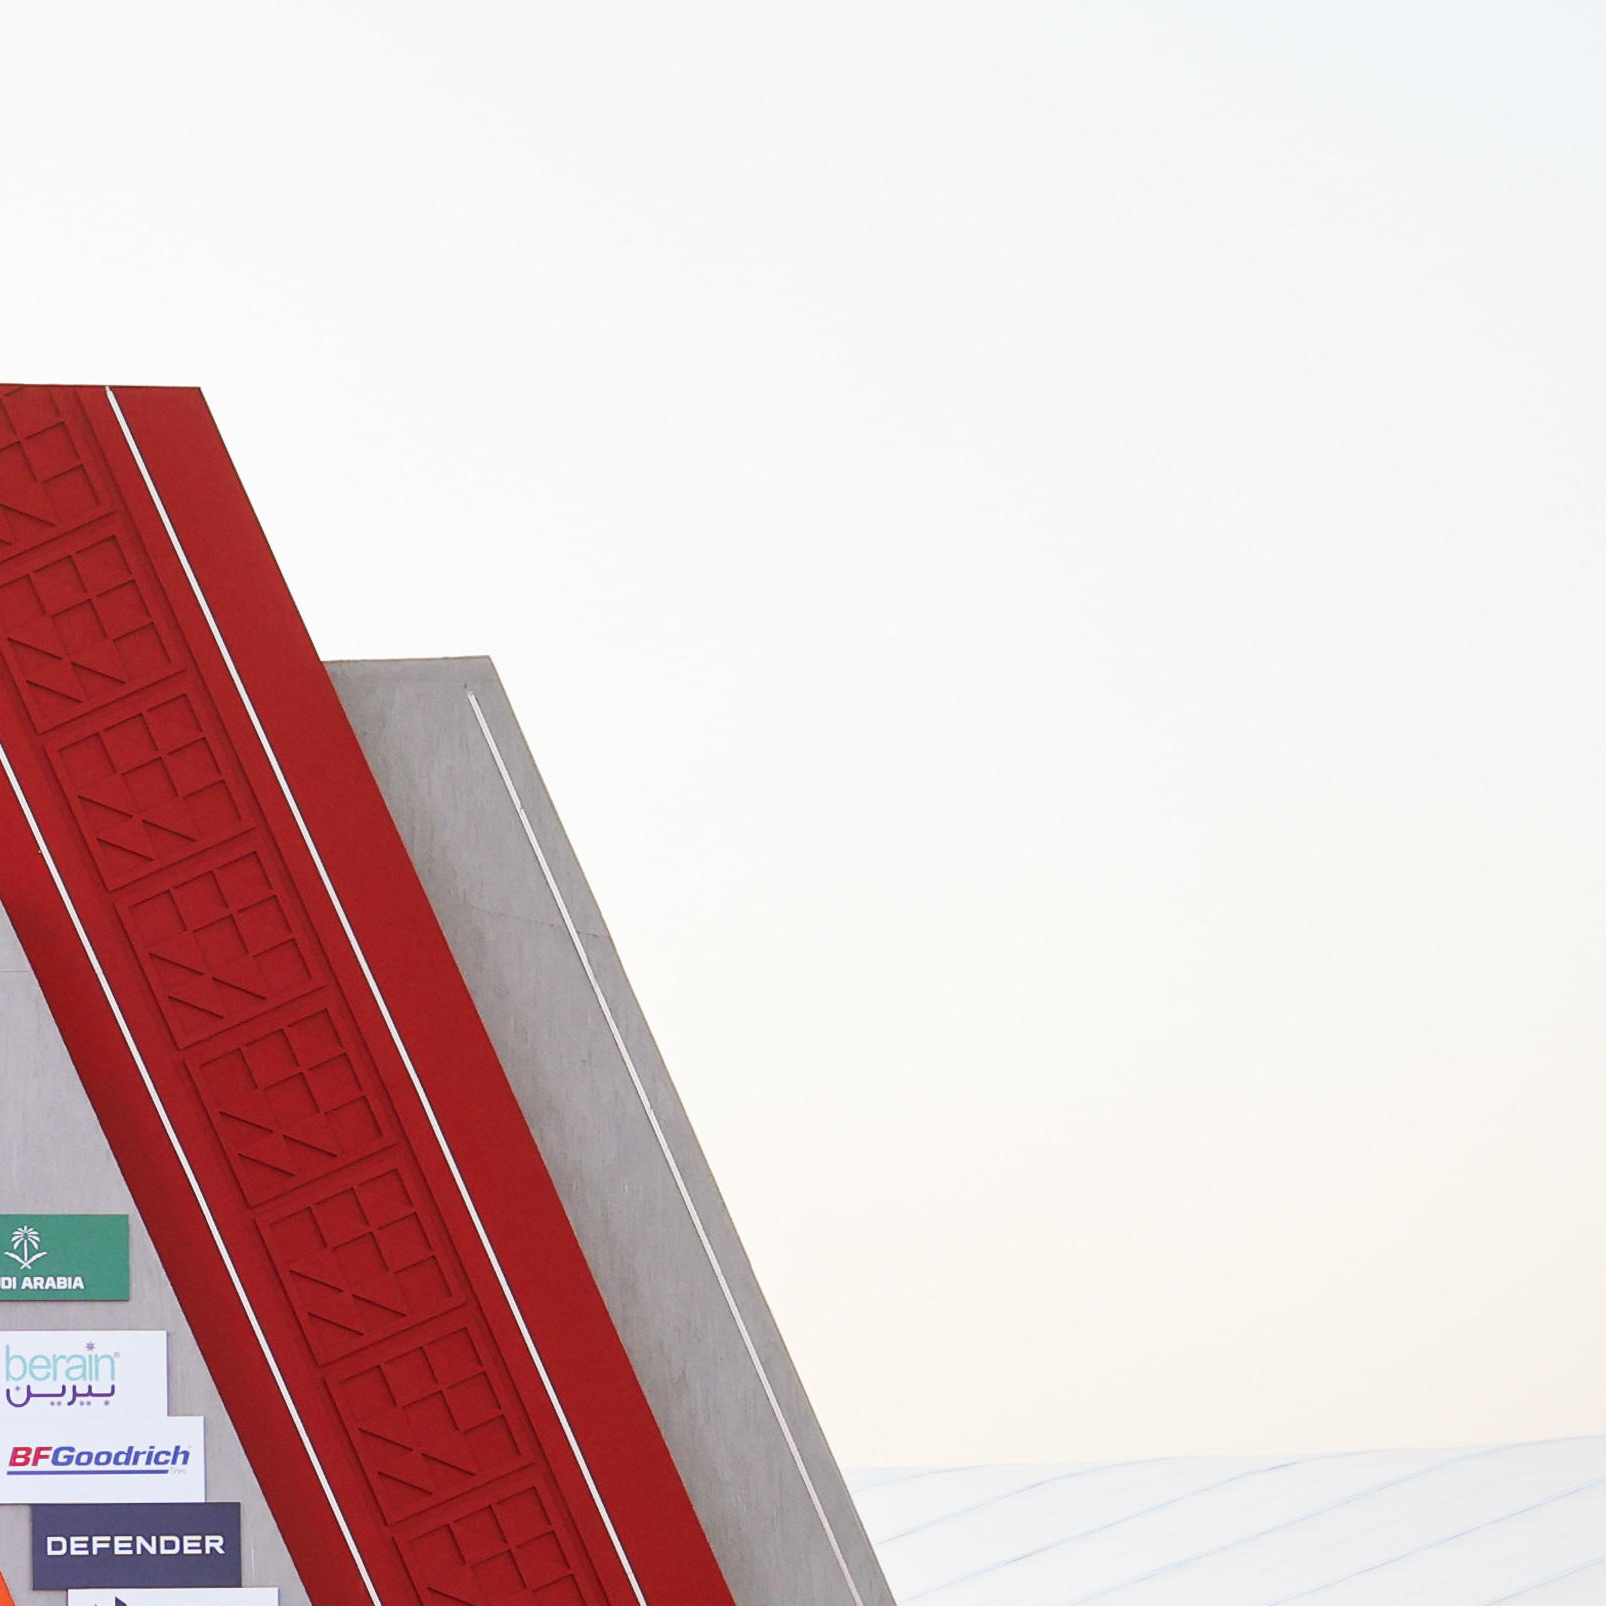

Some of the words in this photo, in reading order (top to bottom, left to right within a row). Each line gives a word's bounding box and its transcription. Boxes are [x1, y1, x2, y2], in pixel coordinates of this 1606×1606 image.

[20, 1276, 85, 1290] ARABIA
[4, 1342, 116, 1382] berain
[5, 1384, 116, 1408] بيرين
[8, 1445, 191, 1467] BFGoodrich
[46, 1535, 226, 1556] DEFENDER
